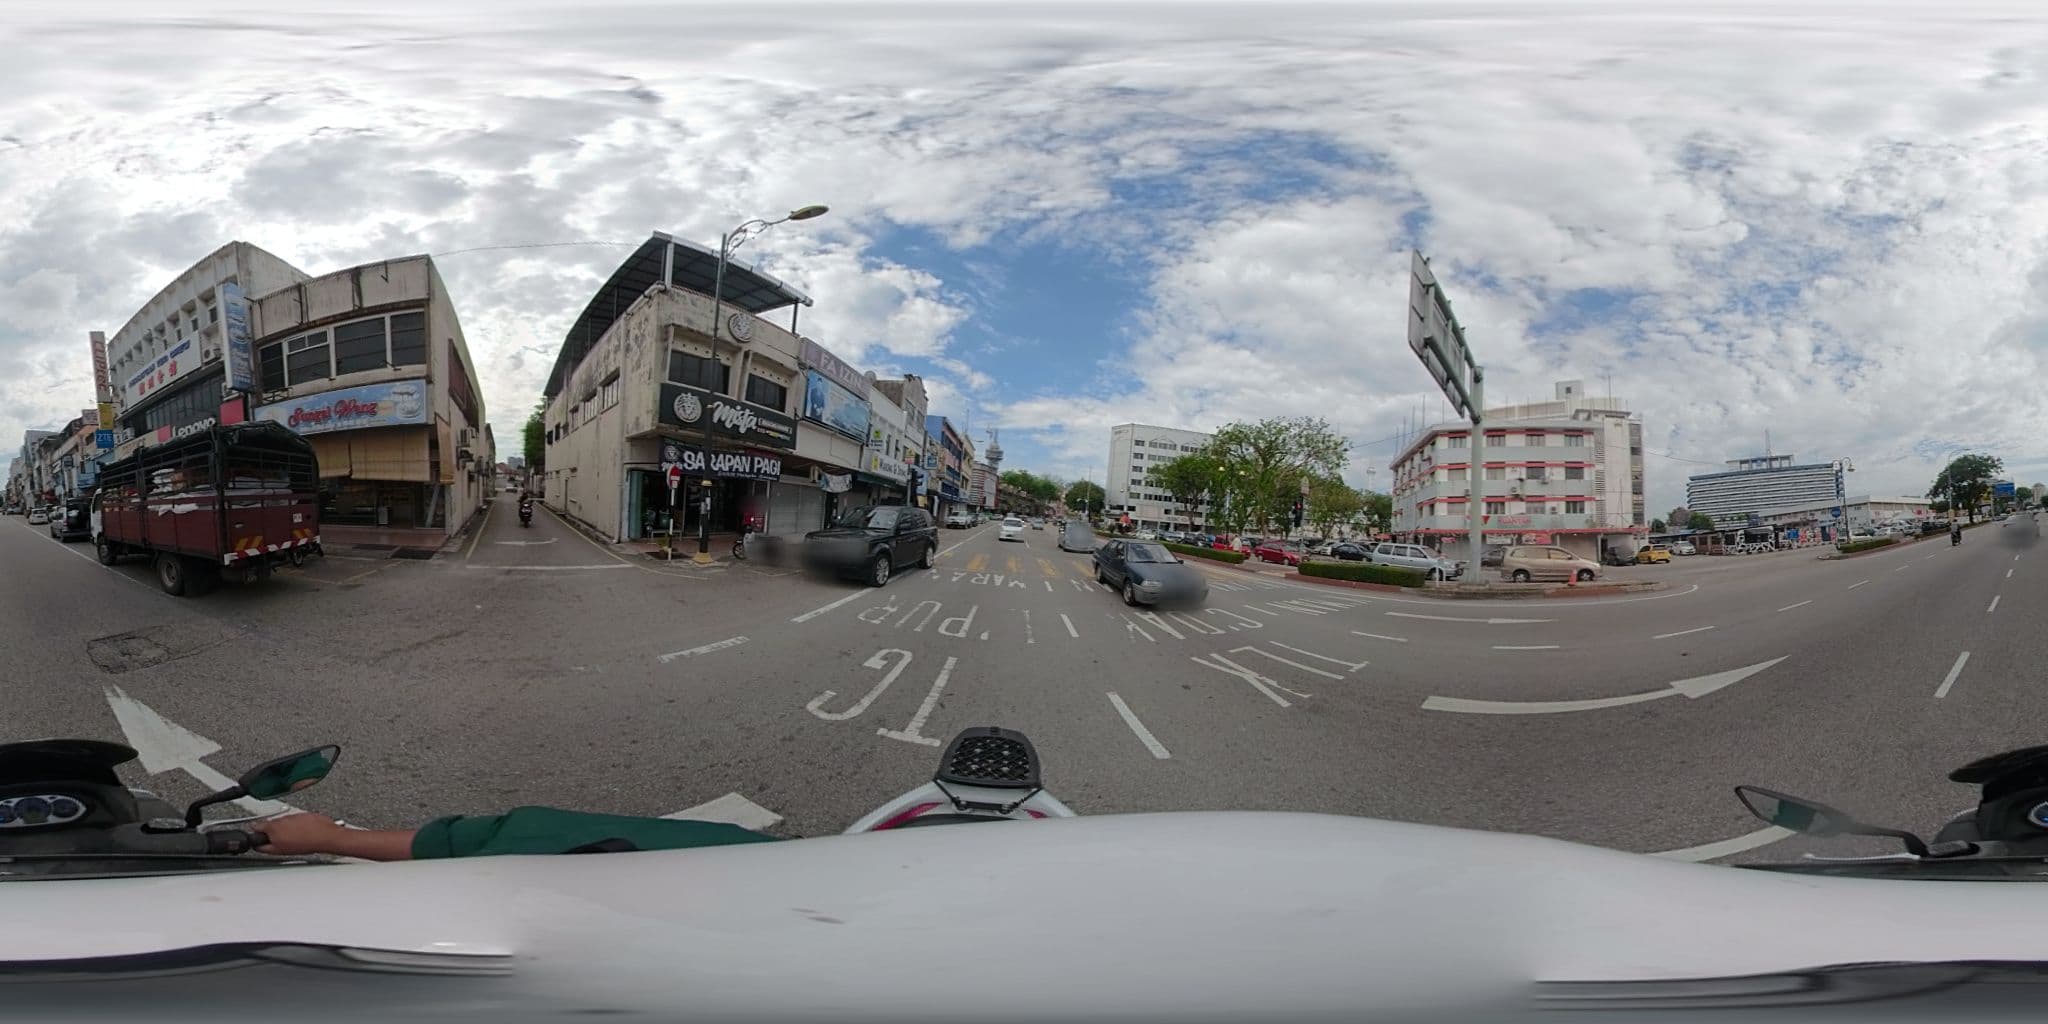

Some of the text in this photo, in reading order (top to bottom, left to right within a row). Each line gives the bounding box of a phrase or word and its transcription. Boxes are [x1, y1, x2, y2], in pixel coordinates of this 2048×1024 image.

[172, 417, 216, 438] Lenovo
[712, 401, 758, 433] Mista
[97, 433, 113, 442] ZTE
[754, 457, 781, 476] PAGI
[1190, 640, 1370, 708] TLK
[805, 647, 957, 747] TG
